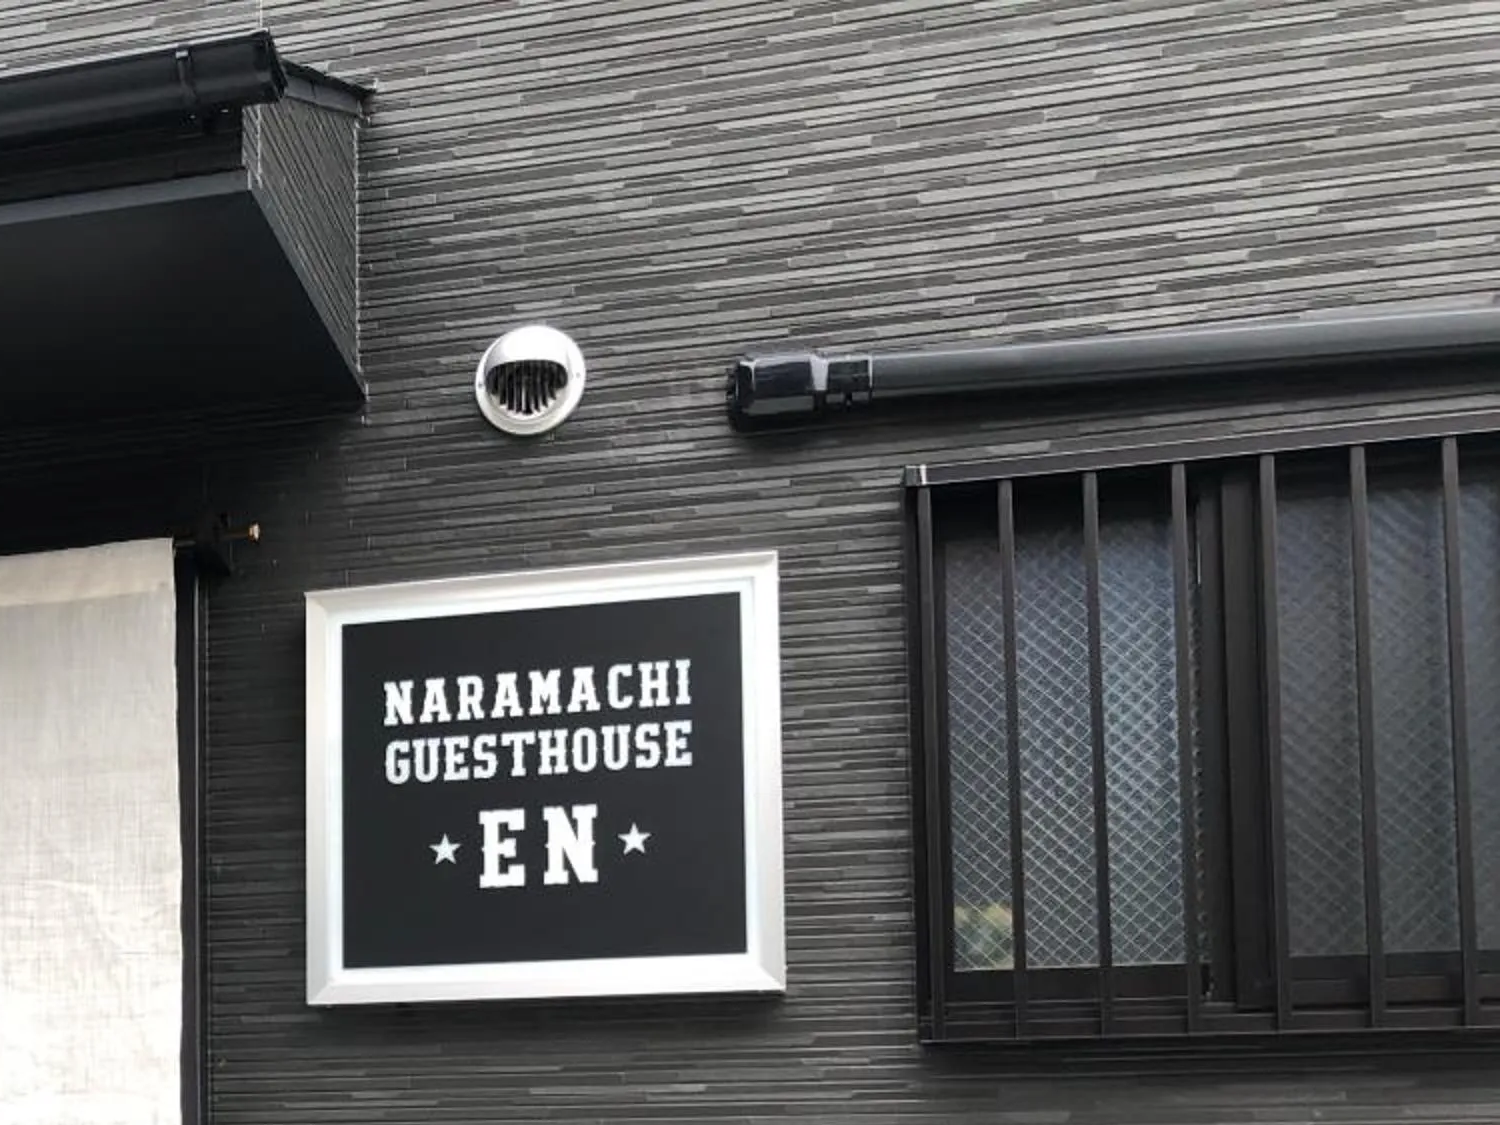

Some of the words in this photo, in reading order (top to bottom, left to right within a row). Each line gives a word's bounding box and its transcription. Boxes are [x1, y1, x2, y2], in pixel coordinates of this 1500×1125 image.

[383, 658, 692, 726] NARAMACHI
[385, 719, 693, 785] GUESTHOUSE
[479, 803, 599, 889] EN
